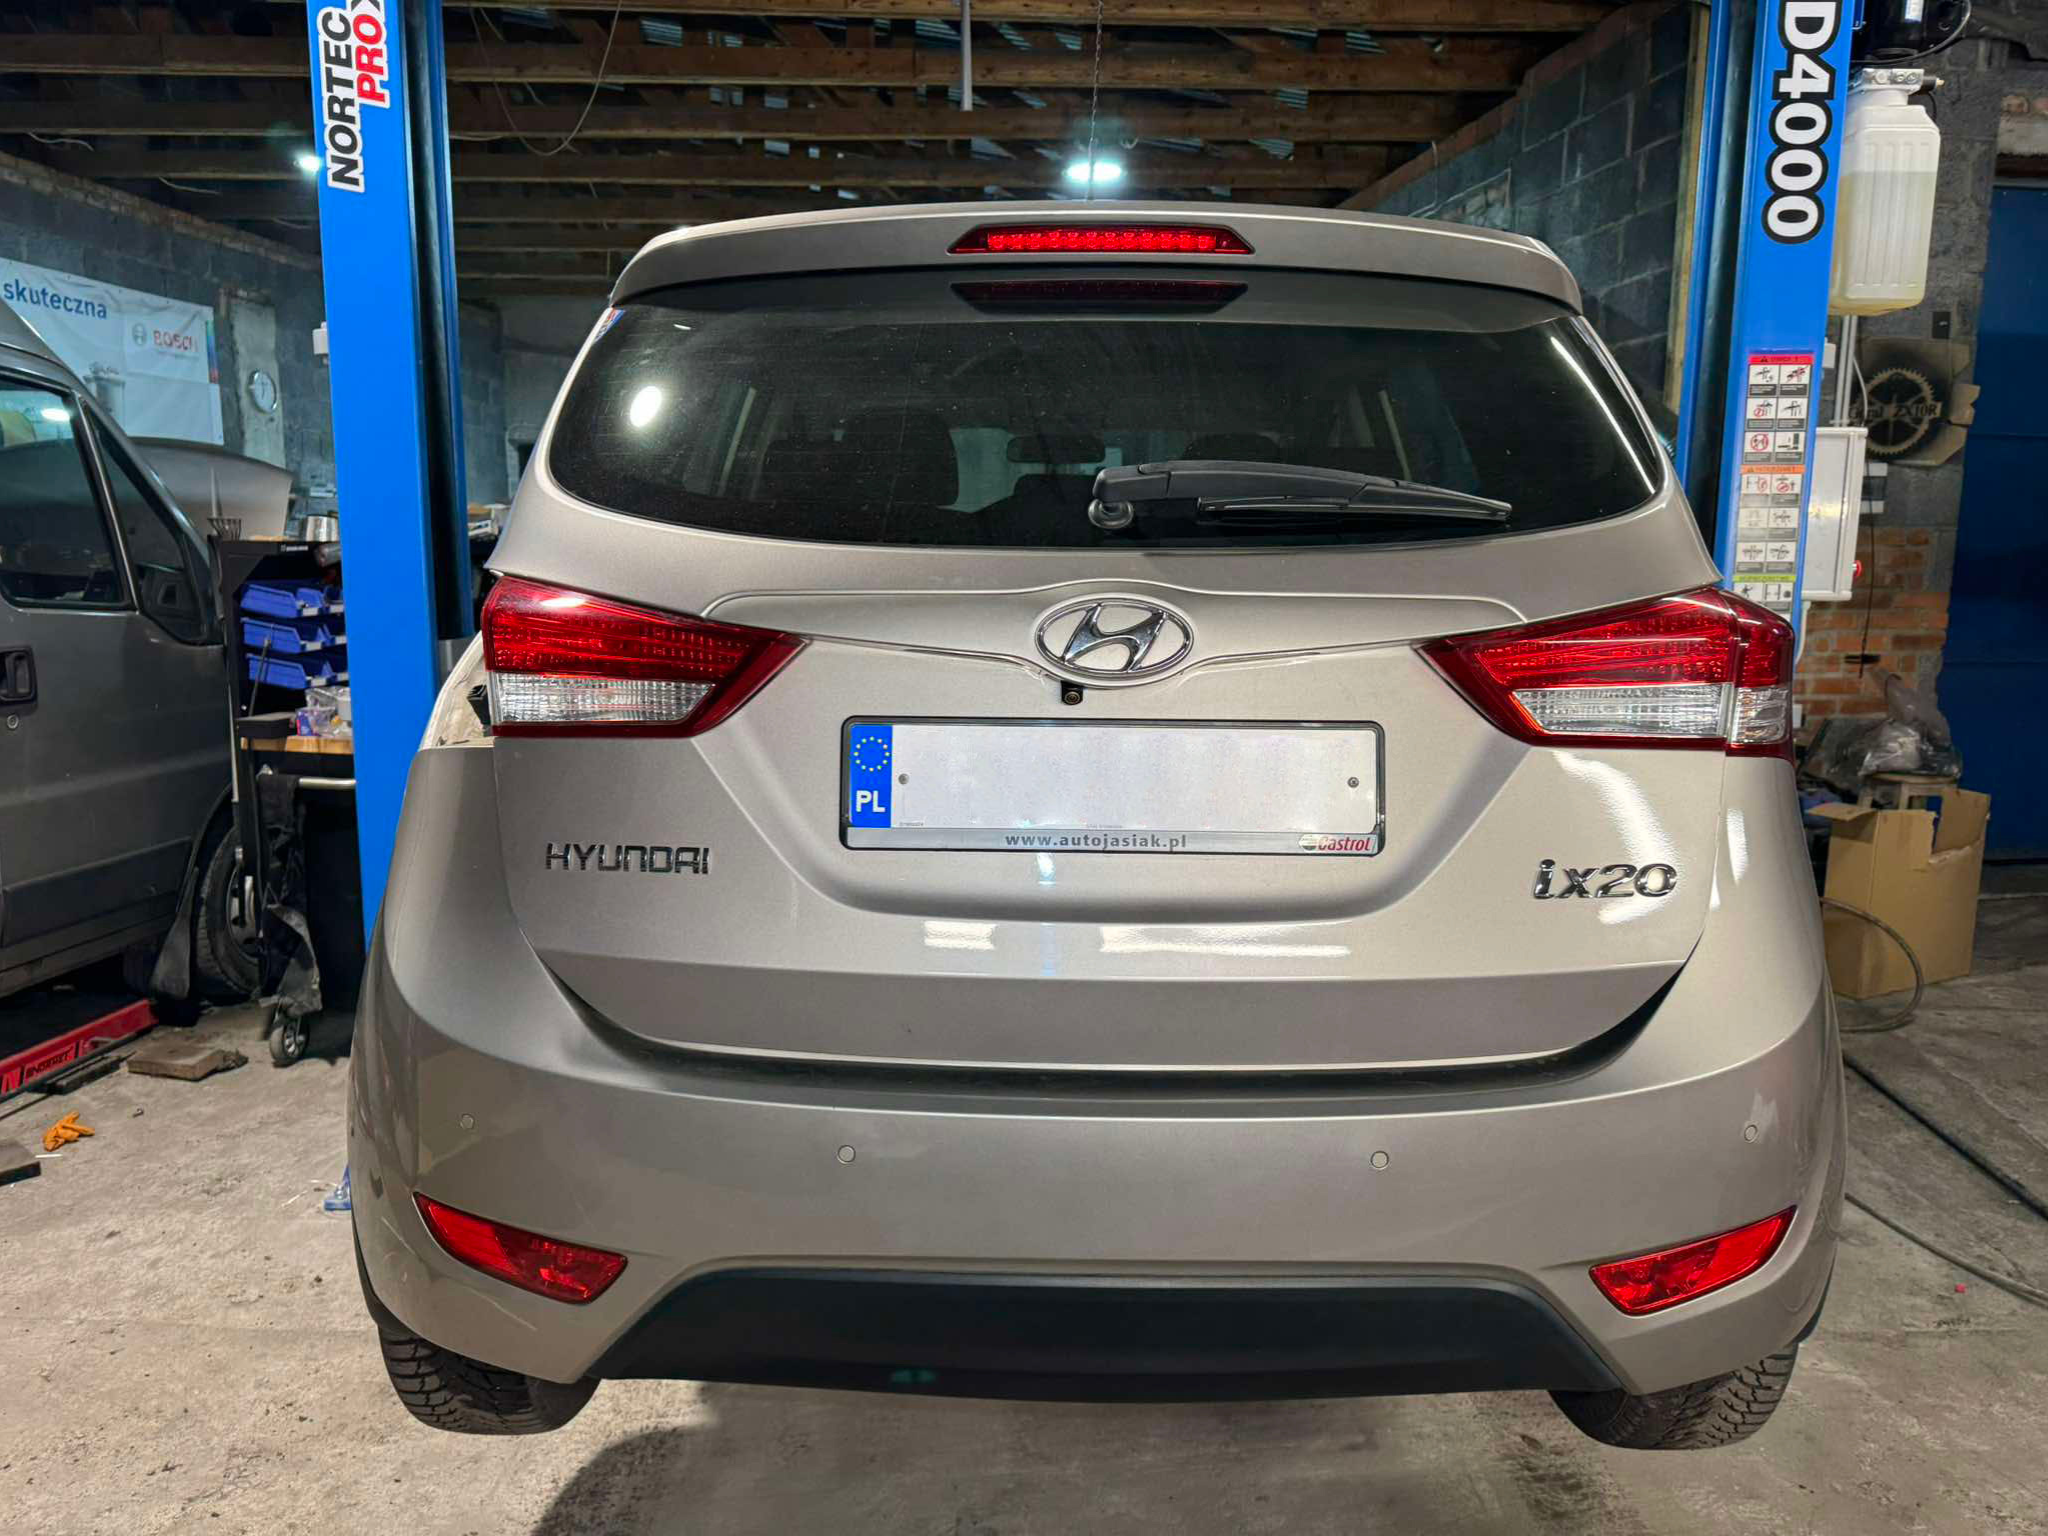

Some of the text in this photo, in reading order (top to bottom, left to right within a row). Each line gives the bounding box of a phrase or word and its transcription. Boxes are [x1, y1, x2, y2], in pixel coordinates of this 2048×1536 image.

[321, 11, 360, 187] NORTEC
[1767, 1, 1837, 238] D4000
[3, 278, 108, 319] skuteczna
[855, 790, 886, 812] PL
[546, 843, 709, 875] HYUNDAI
[1005, 833, 1187, 852] www.autojasiak.pl
[1318, 836, 1371, 851] Castrol
[1534, 859, 1678, 899] ix20
